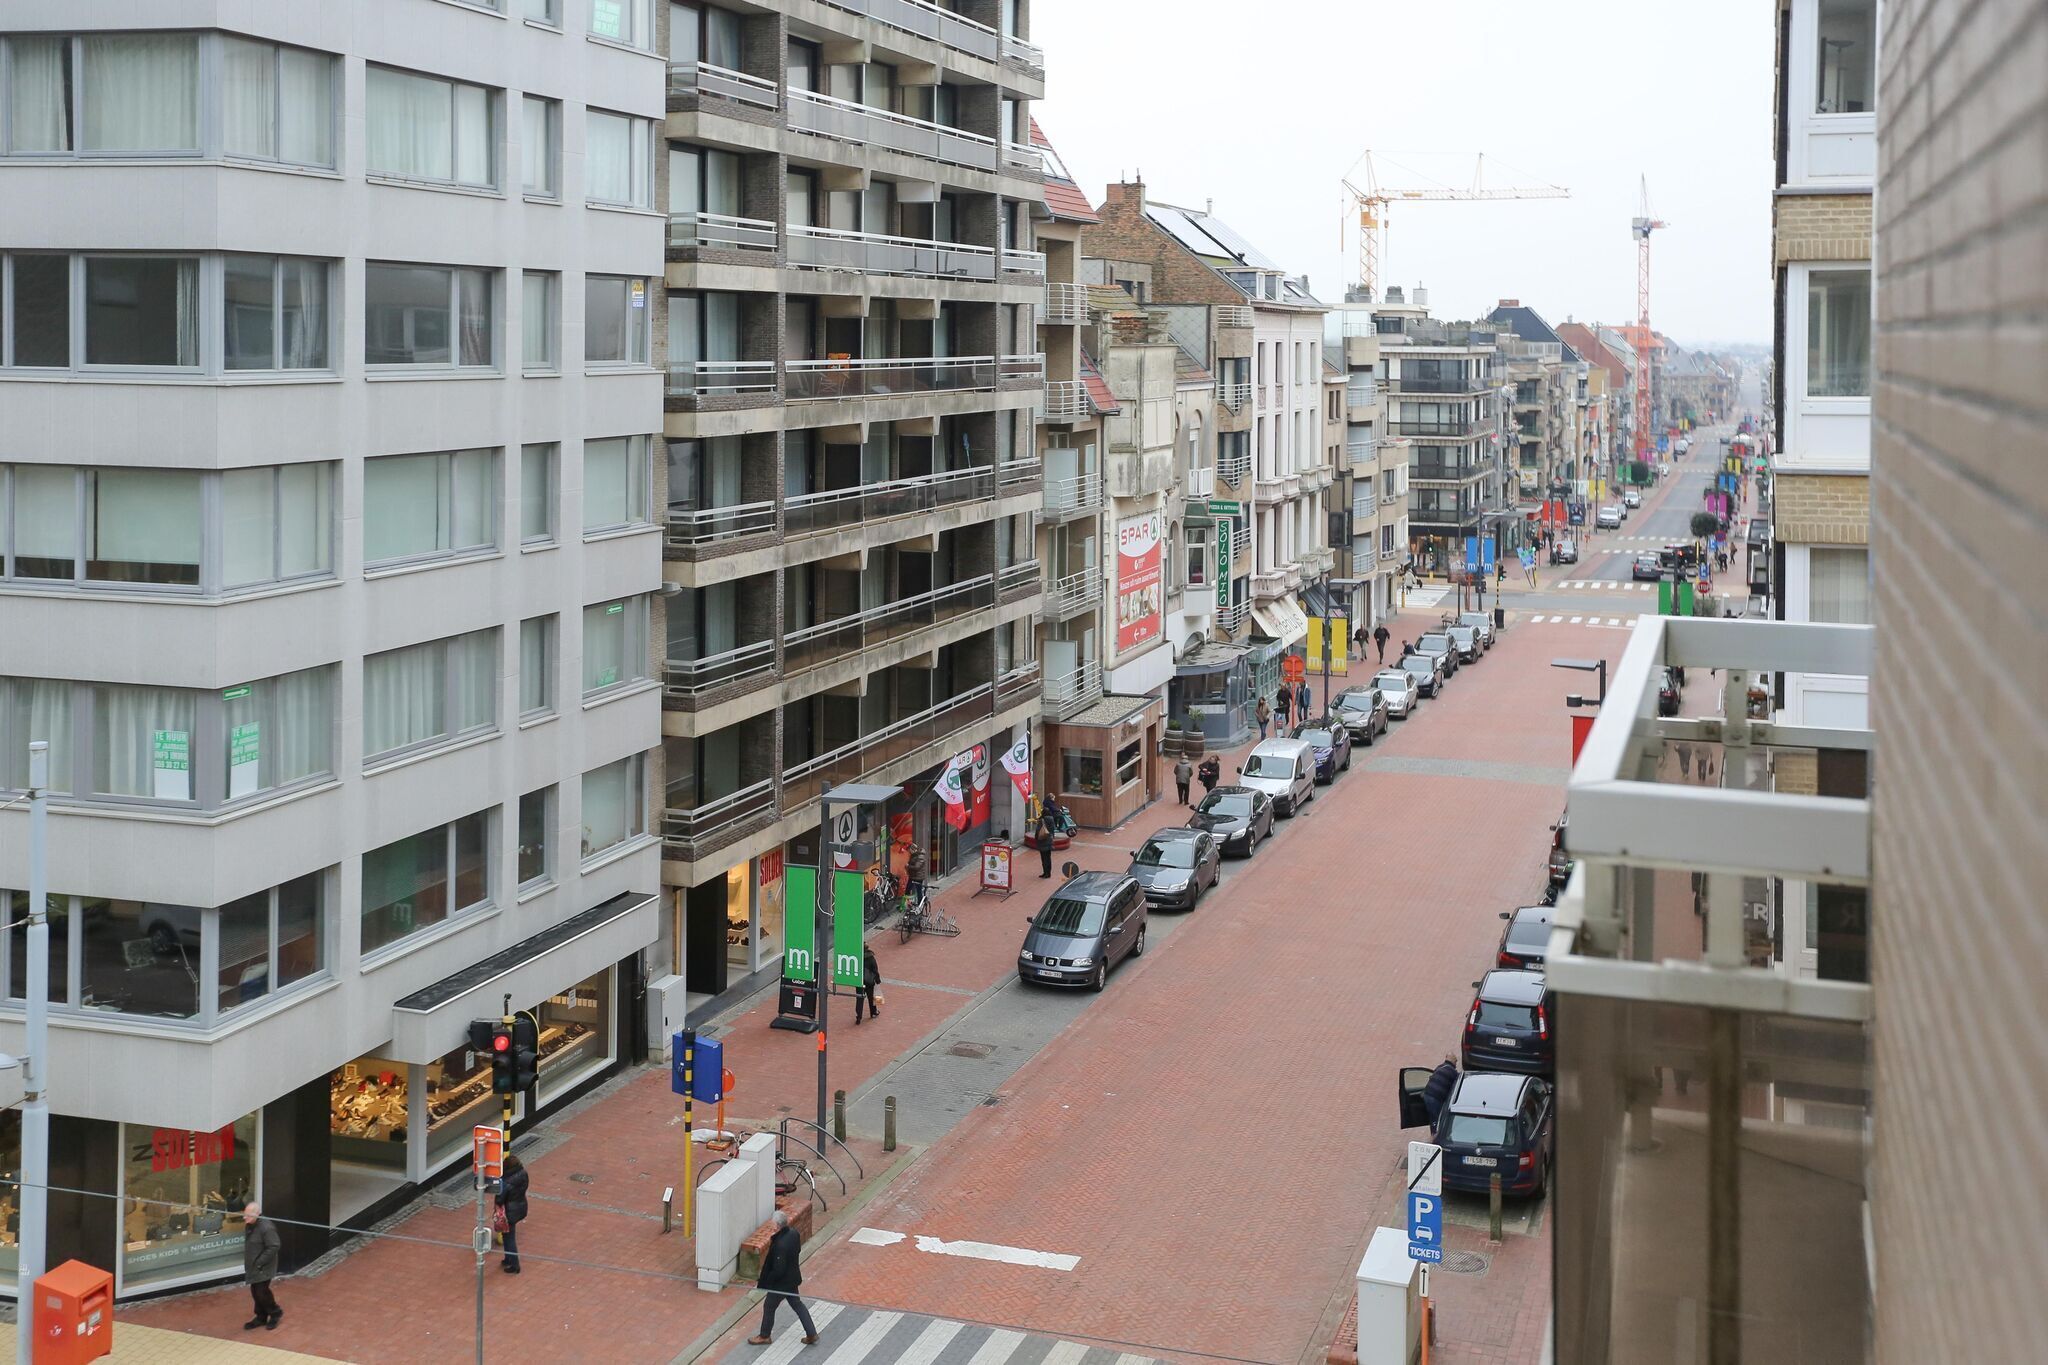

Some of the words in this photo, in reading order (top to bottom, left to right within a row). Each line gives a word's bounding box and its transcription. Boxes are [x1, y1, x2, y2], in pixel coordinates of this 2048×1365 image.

[1121, 523, 1149, 546] SPAR
[1219, 521, 1228, 566] SOLO
[1467, 562, 1476, 570] m
[1484, 562, 1492, 571] m
[1218, 571, 1229, 605] MIO
[154, 731, 164, 741] TE
[167, 732, 187, 742] HUUR
[1005, 754, 1017, 770] SPAR
[939, 783, 957, 801] SPAR
[789, 948, 809, 970] m
[837, 954, 858, 976] m
[1415, 1196, 1433, 1223] P
[128, 1253, 157, 1264] SHOES
[159, 1248, 180, 1258] KIDS
[190, 1240, 224, 1252] NIKELLI
[225, 1235, 246, 1245] KIDS
[1410, 1246, 1440, 1260] TICKETS
